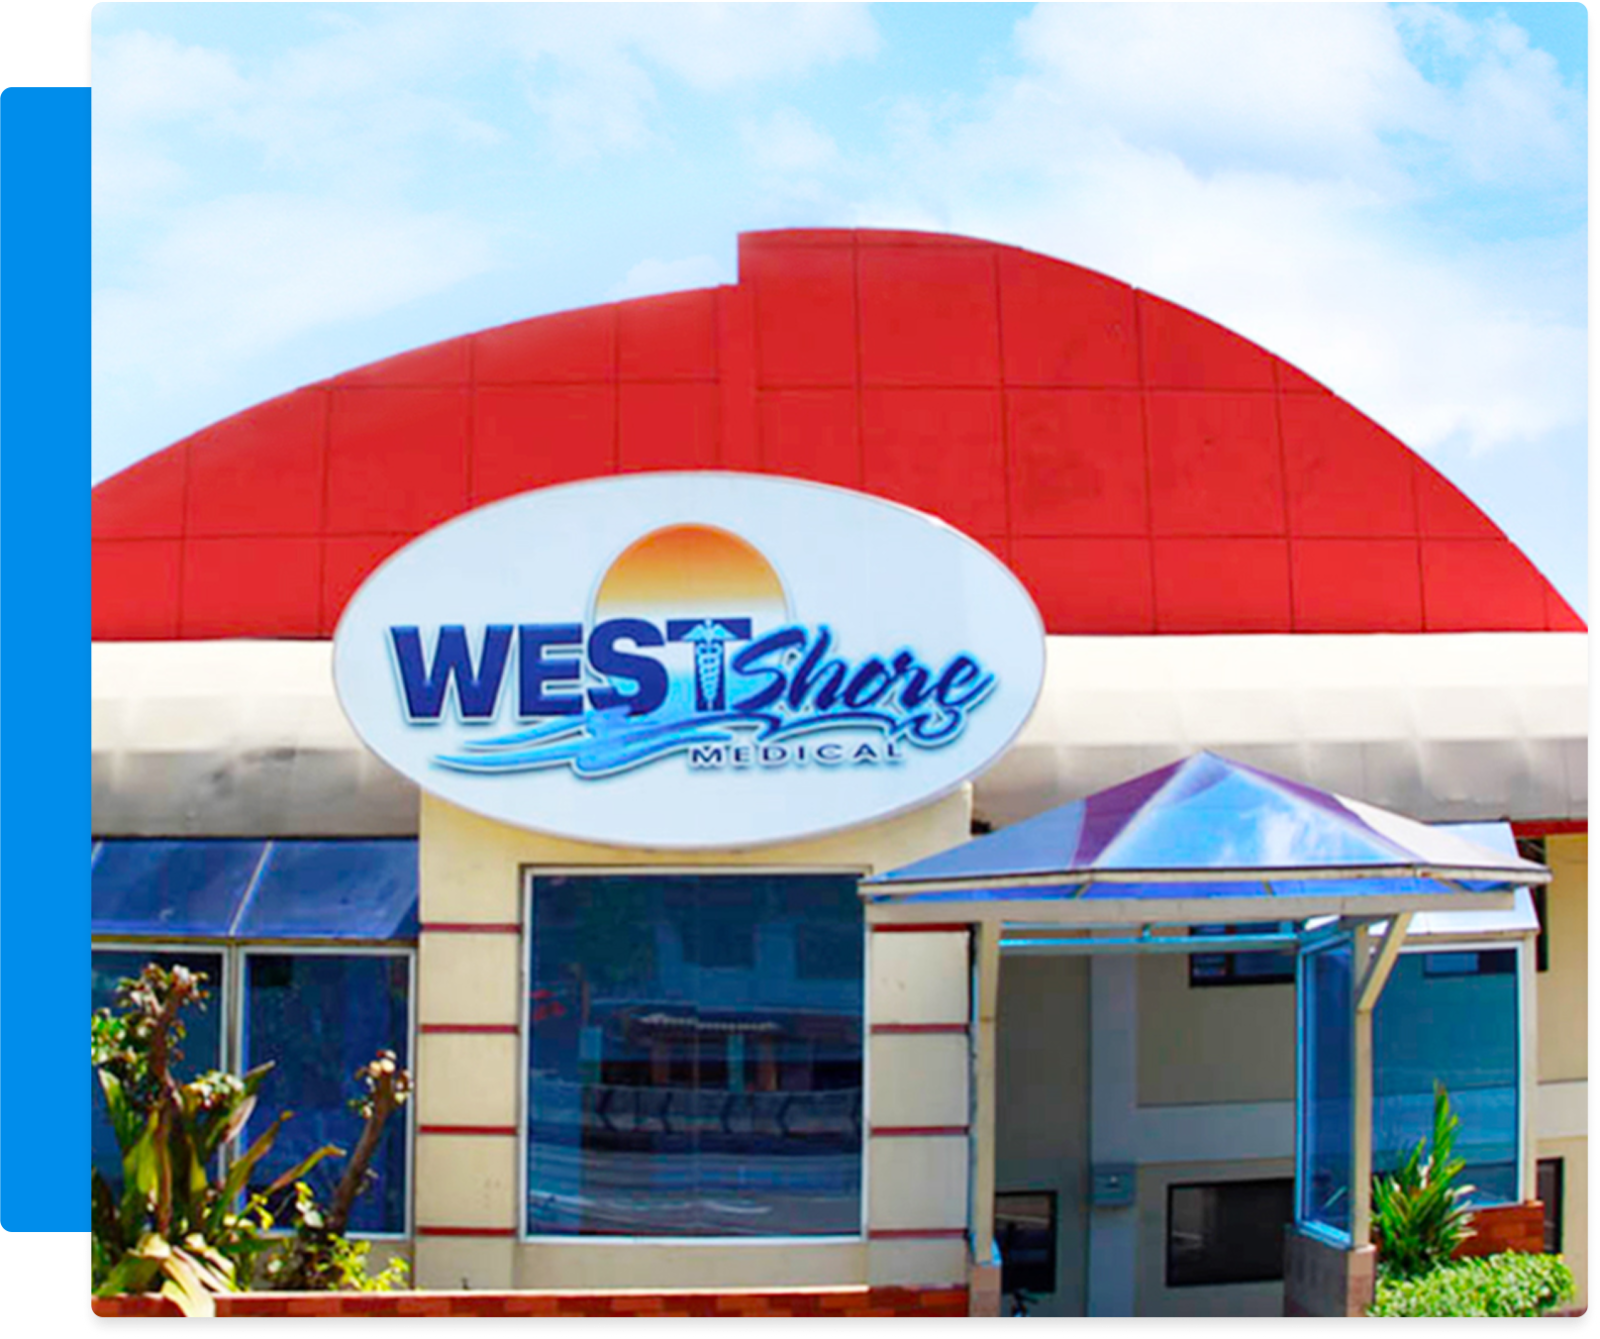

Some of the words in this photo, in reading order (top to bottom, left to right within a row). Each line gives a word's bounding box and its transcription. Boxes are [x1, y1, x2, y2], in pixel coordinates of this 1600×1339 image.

[391, 618, 752, 719] WEST
[731, 625, 995, 737] Shore
[691, 742, 903, 765] MEDICAL
